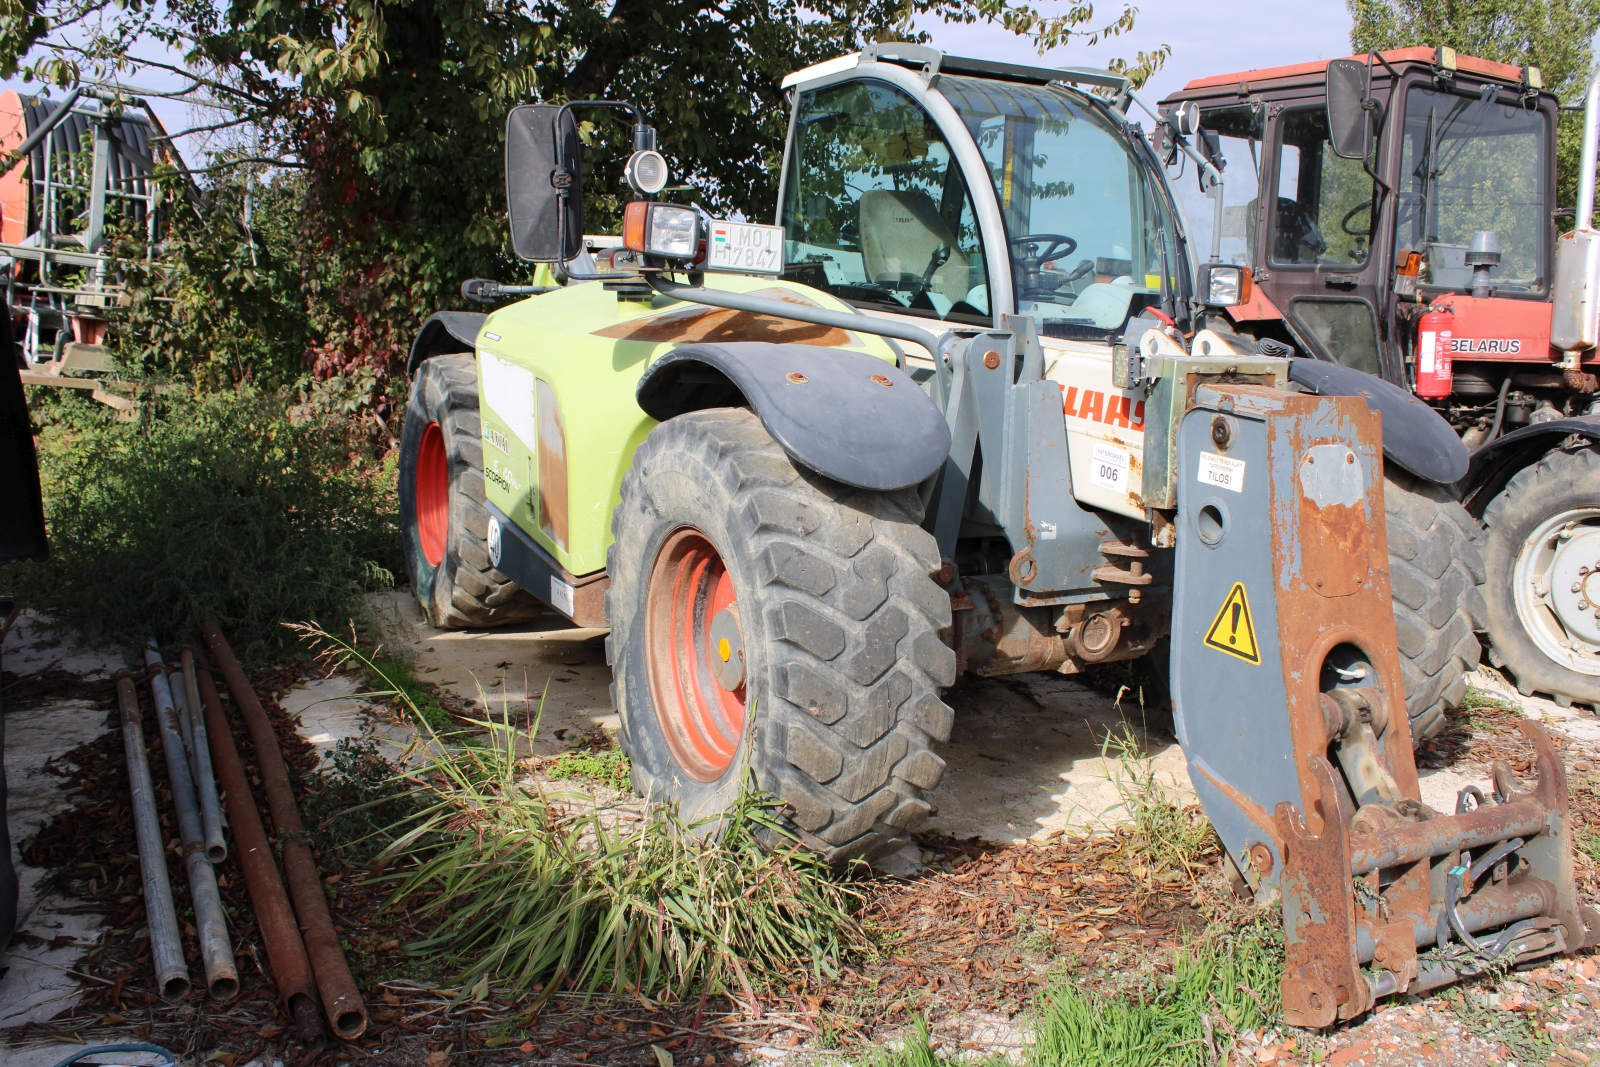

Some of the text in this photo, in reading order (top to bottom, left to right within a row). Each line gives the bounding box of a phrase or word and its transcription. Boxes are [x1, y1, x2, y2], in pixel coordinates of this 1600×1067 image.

[732, 245, 778, 269] 7847
[1452, 339, 1520, 353] BELARUS
[1058, 383, 1145, 432] LAAS
[485, 467, 511, 493] SCORPION
[1100, 465, 1118, 481] 006
[1208, 470, 1232, 485] TILOS!
